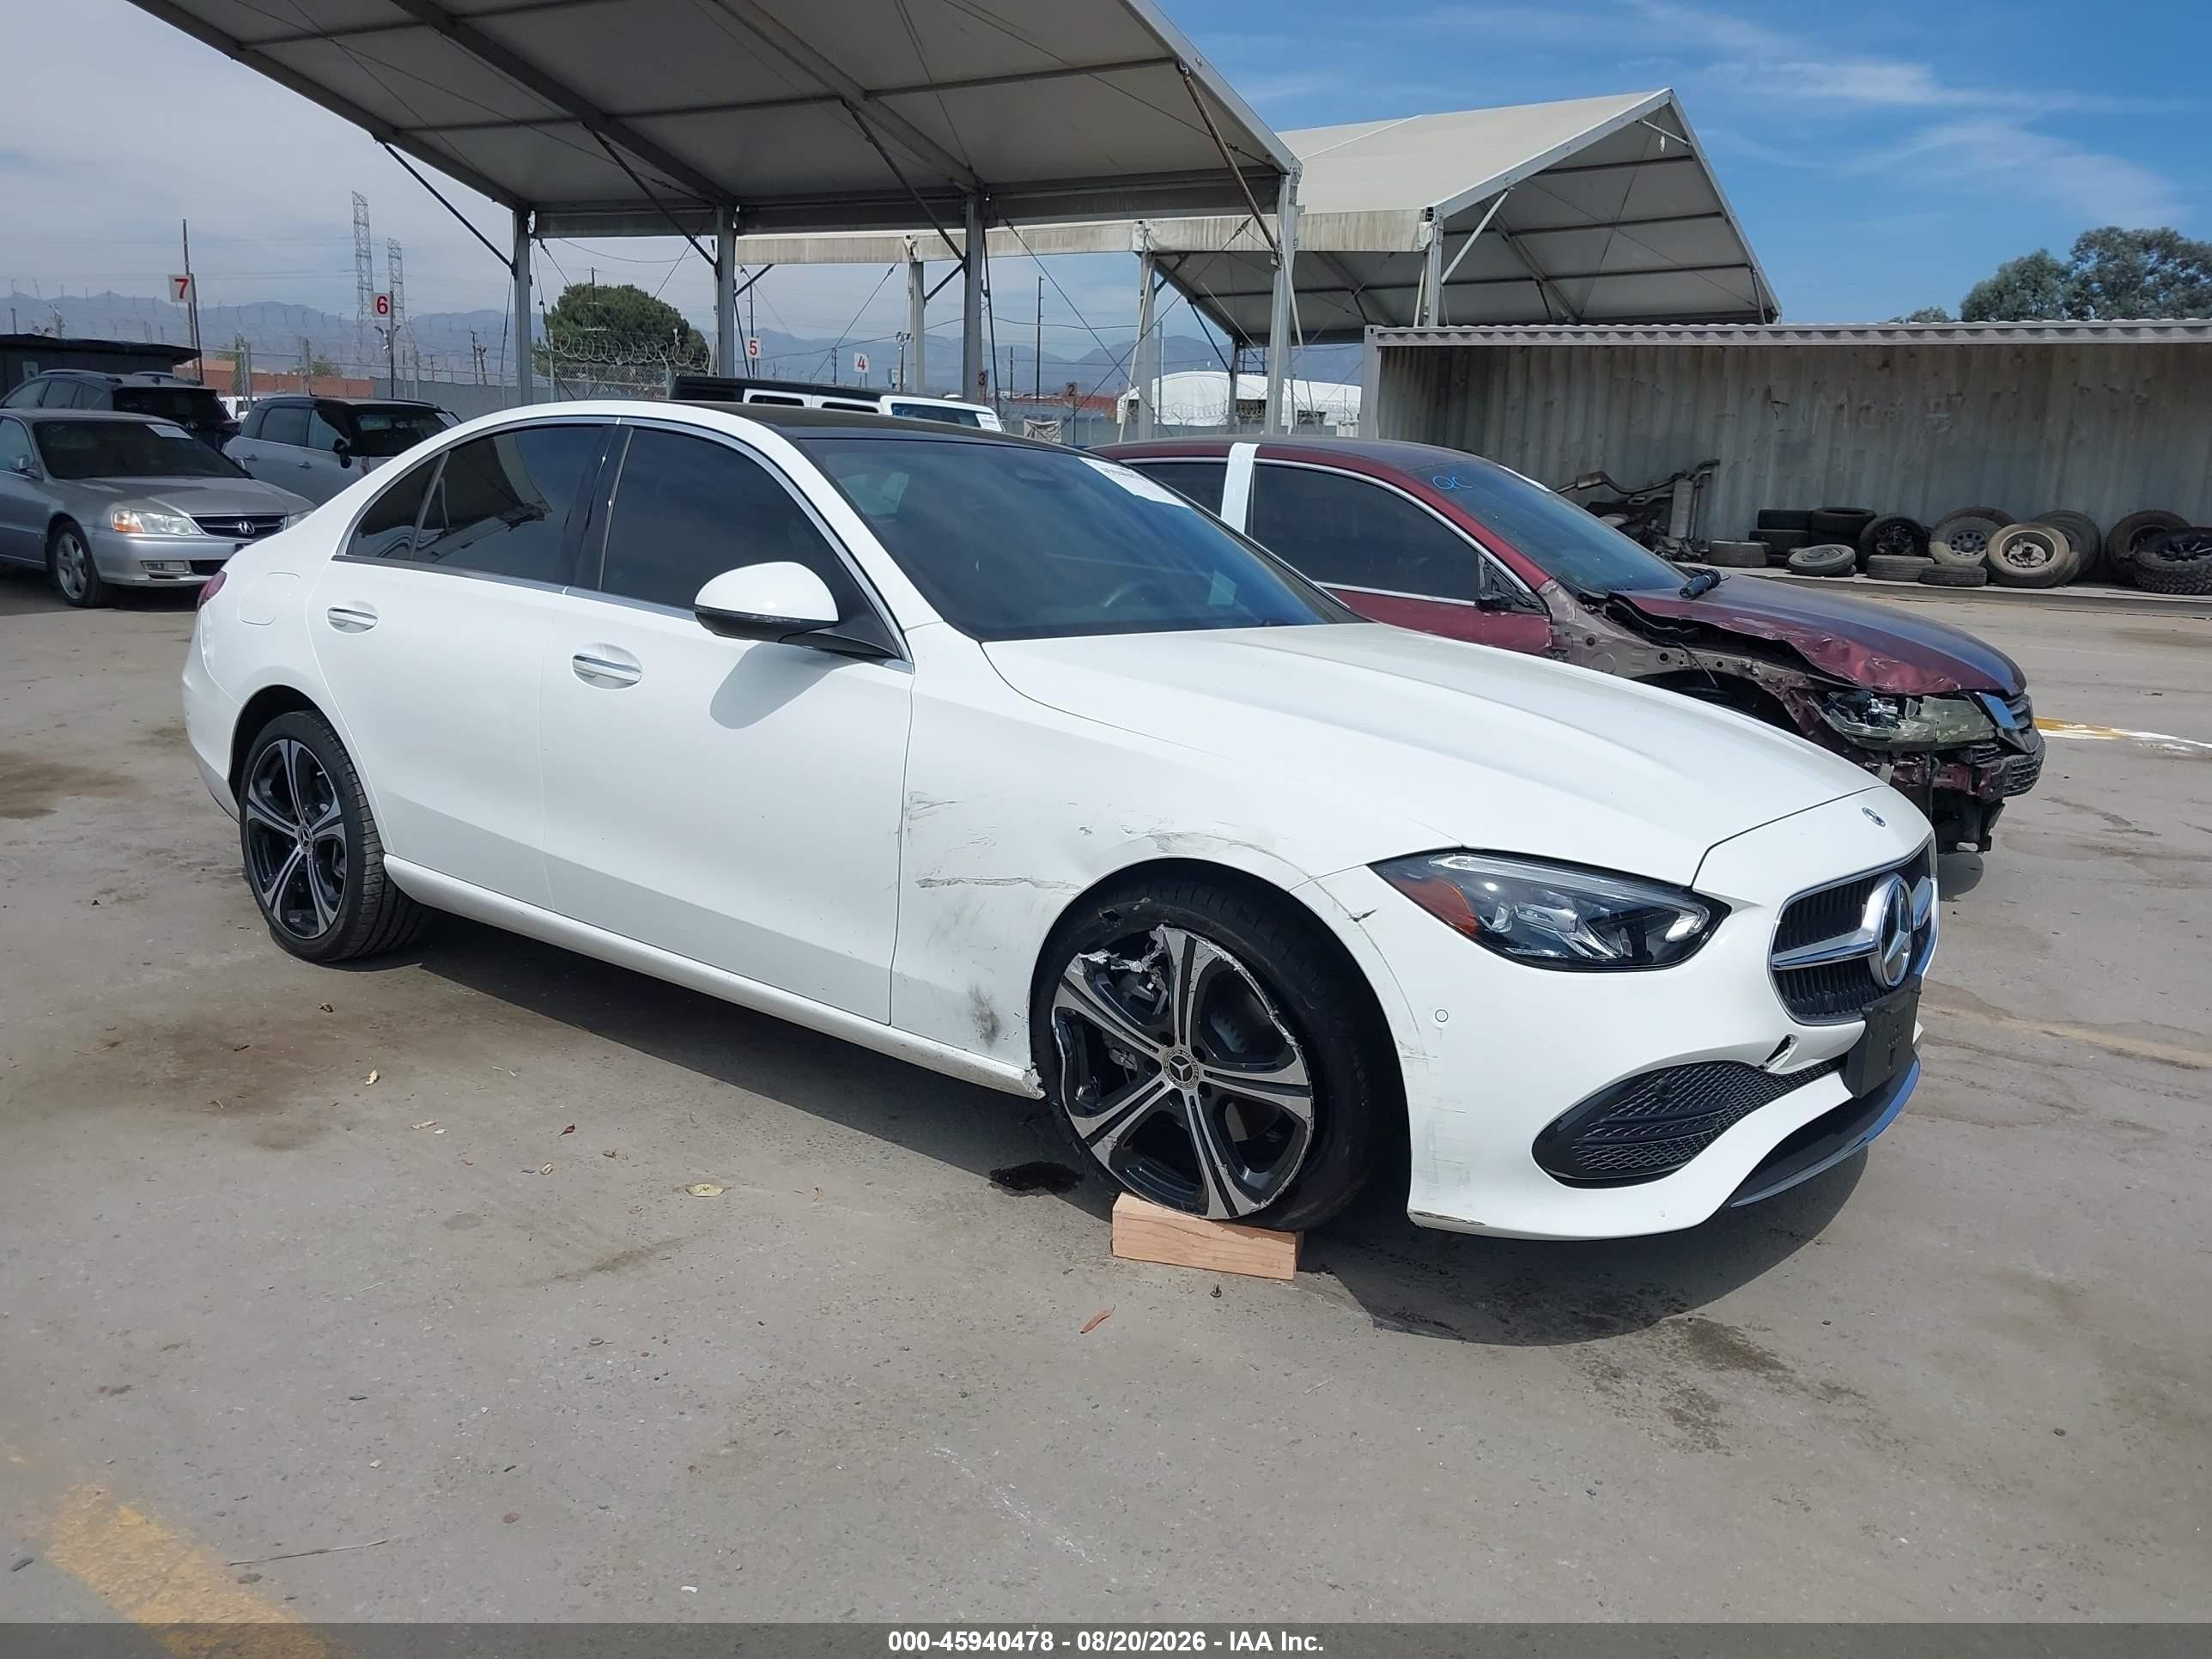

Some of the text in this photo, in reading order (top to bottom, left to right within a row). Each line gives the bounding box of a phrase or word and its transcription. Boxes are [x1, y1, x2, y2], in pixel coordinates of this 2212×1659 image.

[174, 278, 189, 300] 7
[376, 295, 388, 315] 6
[749, 340, 757, 356] 5
[857, 356, 866, 371] 4
[978, 372, 986, 386] 3
[1068, 384, 1075, 397] 2
